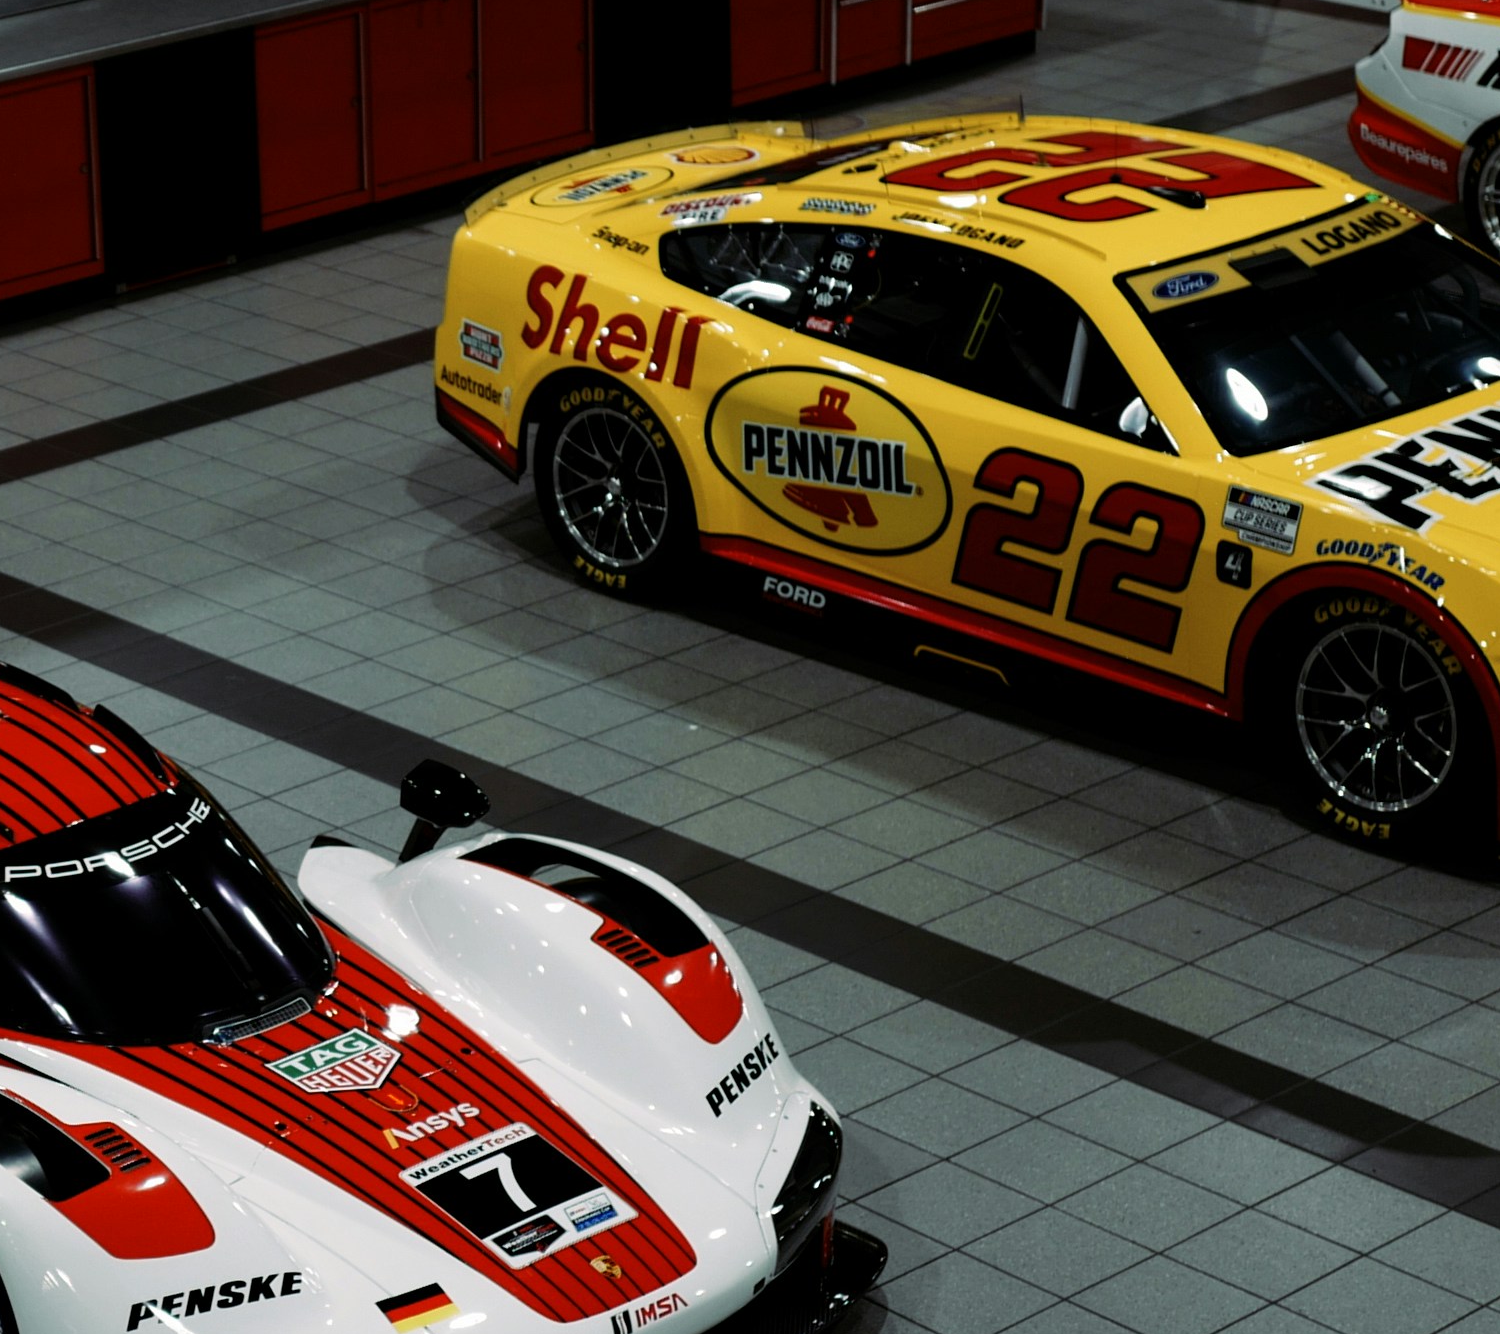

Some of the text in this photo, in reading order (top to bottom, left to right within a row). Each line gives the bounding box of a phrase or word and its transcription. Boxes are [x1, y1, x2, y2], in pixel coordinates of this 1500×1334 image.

[1359, 122, 1449, 174] Beaurepaires
[882, 129, 1317, 224] 22
[660, 192, 758, 216] DISCOUNT
[592, 226, 650, 255] Snap-on
[949, 221, 1025, 249] LOGANO
[1302, 211, 1400, 257] LOGANO
[1162, 275, 1212, 296] Ford
[521, 265, 713, 389] Shell
[441, 366, 502, 405] Autotrader
[559, 386, 668, 450] GOODYEAR
[741, 421, 914, 495] PENNZOIL
[1233, 510, 1288, 535] CUP SERIES
[1248, 494, 1292, 517] NASCAR
[573, 554, 627, 590] EAGLE
[952, 447, 1205, 653] 22
[1224, 550, 1244, 581] 4
[1315, 539, 1445, 590] GOODYEAR
[762, 576, 827, 610] FORD
[1313, 598, 1463, 677] GOODYEAR
[4, 799, 211, 883] PORSCHE
[1315, 797, 1392, 841] EAGLE
[286, 1031, 376, 1071] TAG
[301, 1048, 400, 1092] HEUER
[705, 1032, 780, 1118] PENSKE
[382, 1101, 481, 1150] Ansys
[409, 1124, 527, 1181] WeatherTech
[459, 1152, 538, 1213] 7
[127, 1271, 303, 1331] PENSKE
[635, 1293, 689, 1329] IMSA
